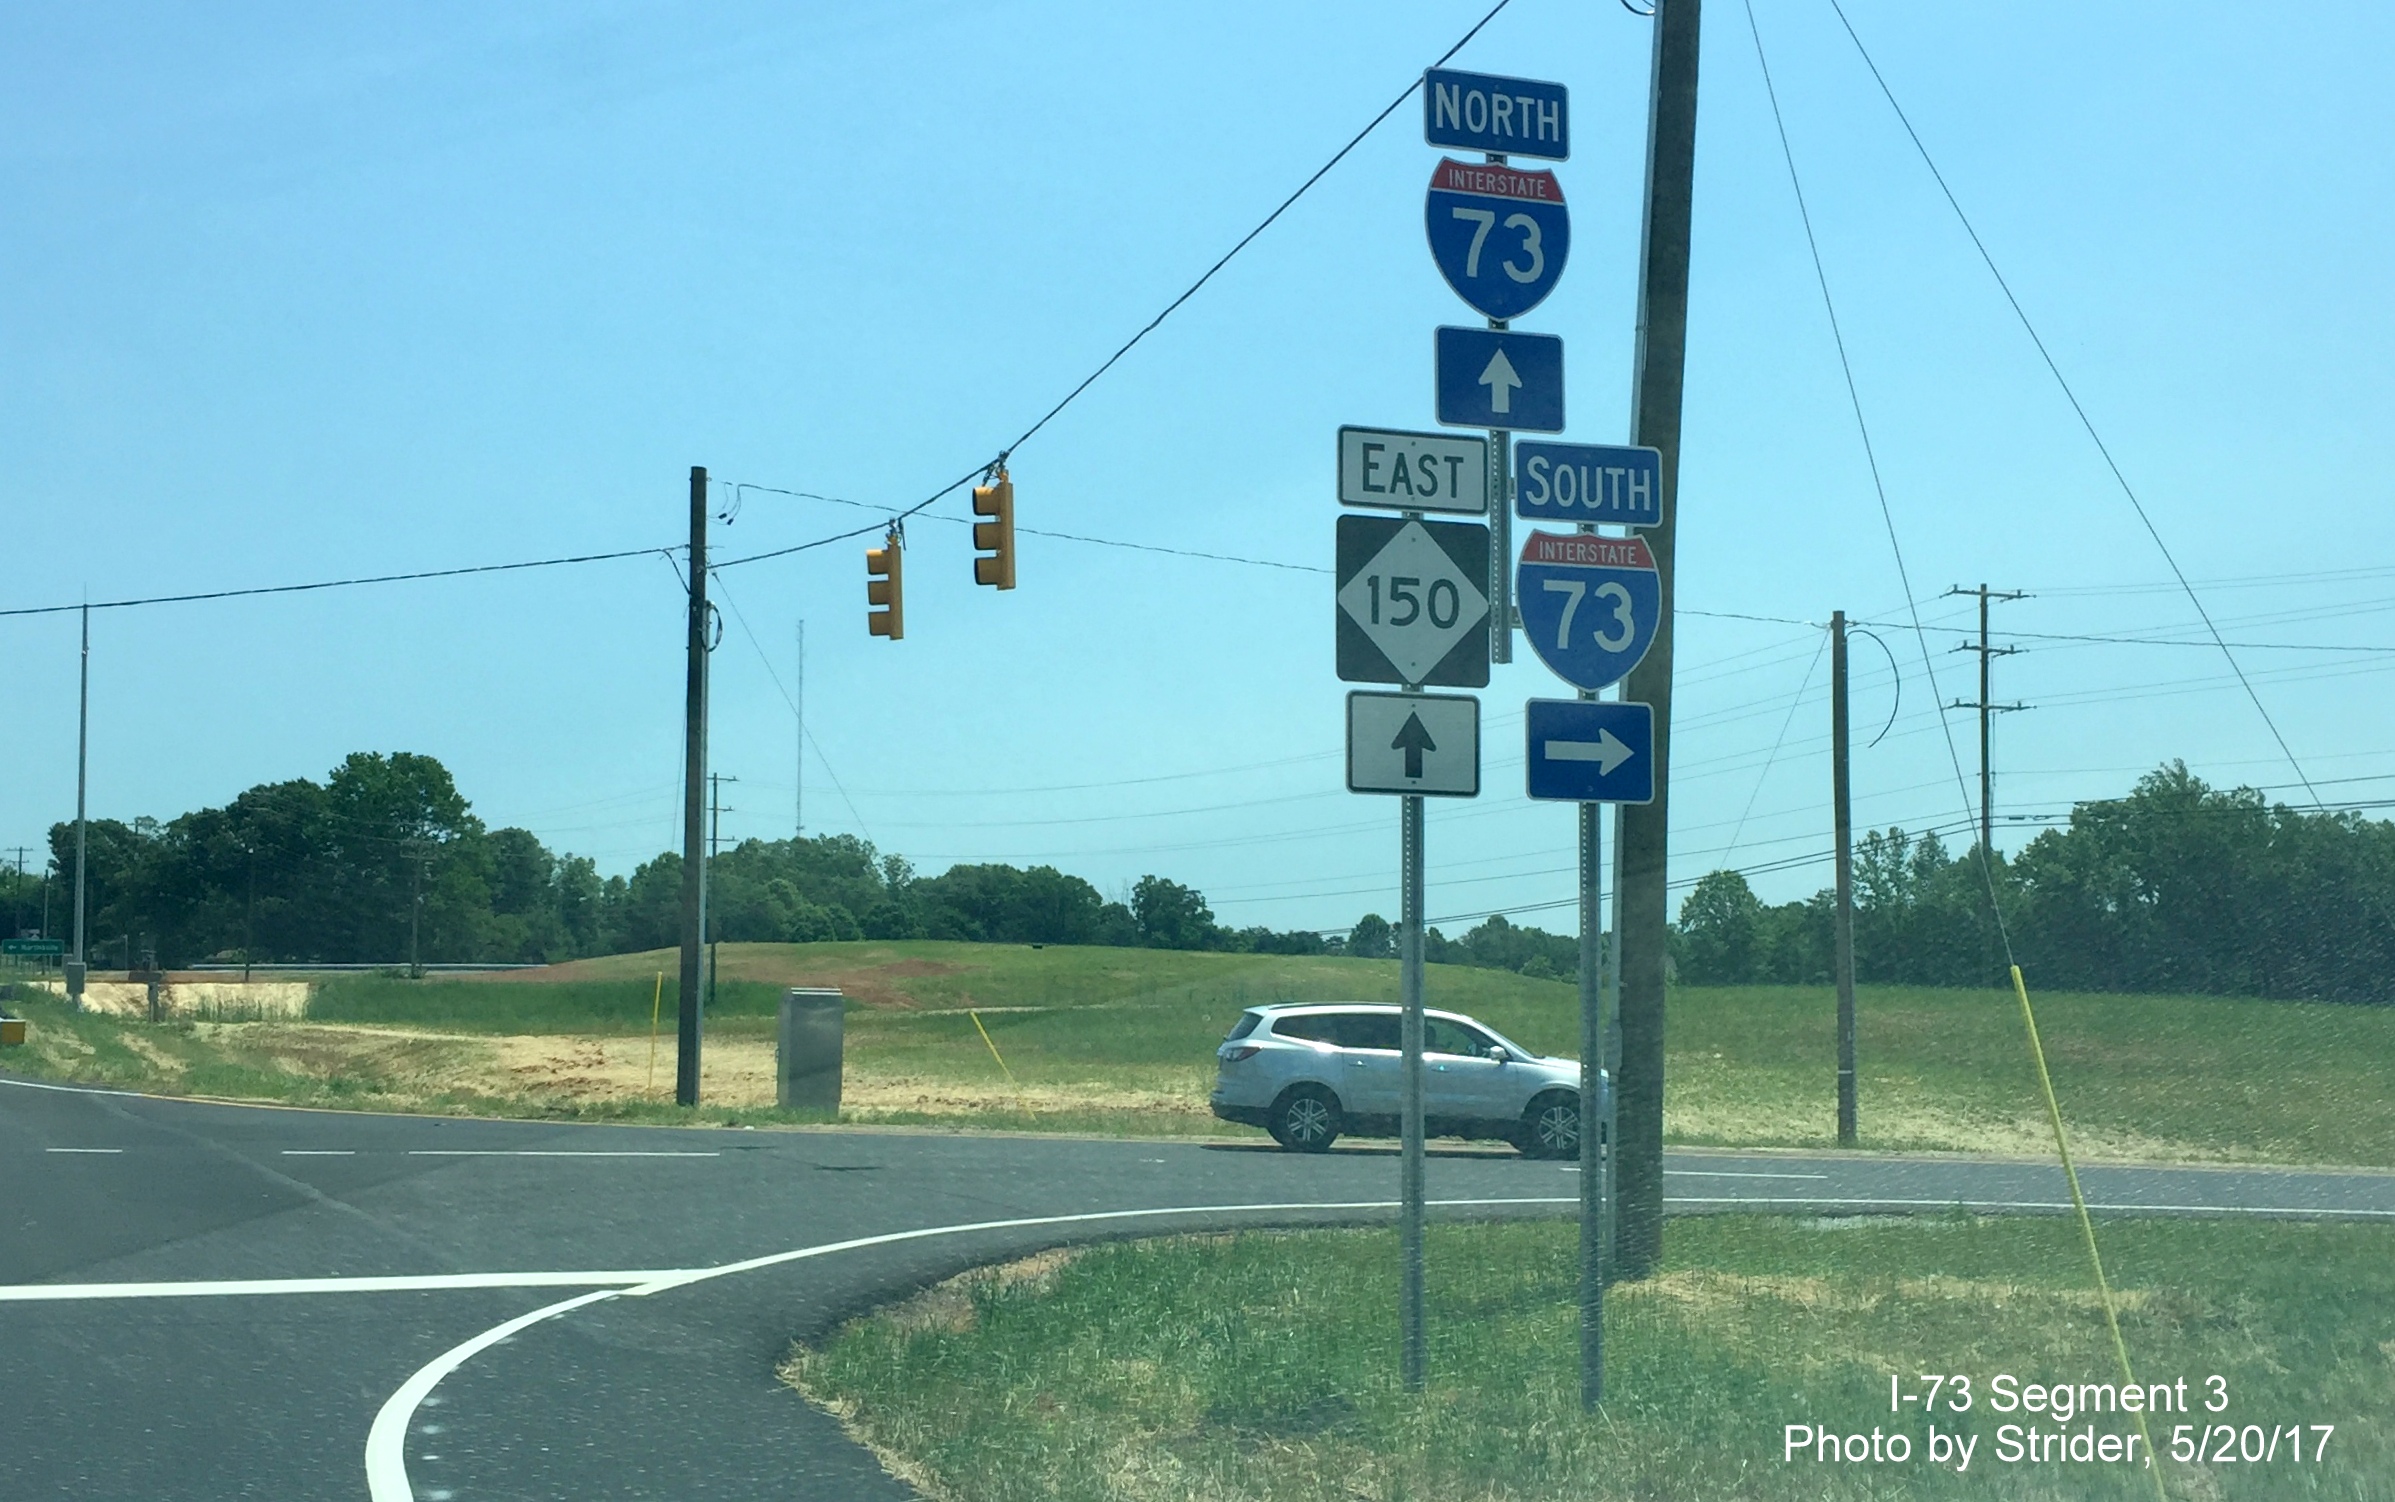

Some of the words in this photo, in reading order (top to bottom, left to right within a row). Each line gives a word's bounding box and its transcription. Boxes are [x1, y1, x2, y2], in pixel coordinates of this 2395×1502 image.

[1435, 82, 1560, 142] NORTH
[1449, 168, 1547, 198] INTERSTATE
[1452, 206, 1545, 284] 73
[1361, 442, 1464, 499] EAST
[1525, 455, 1650, 511] SOUTH
[1538, 541, 1637, 565] INTERSTATE
[1367, 575, 1460, 629] 150
[1543, 579, 1635, 653] 73
